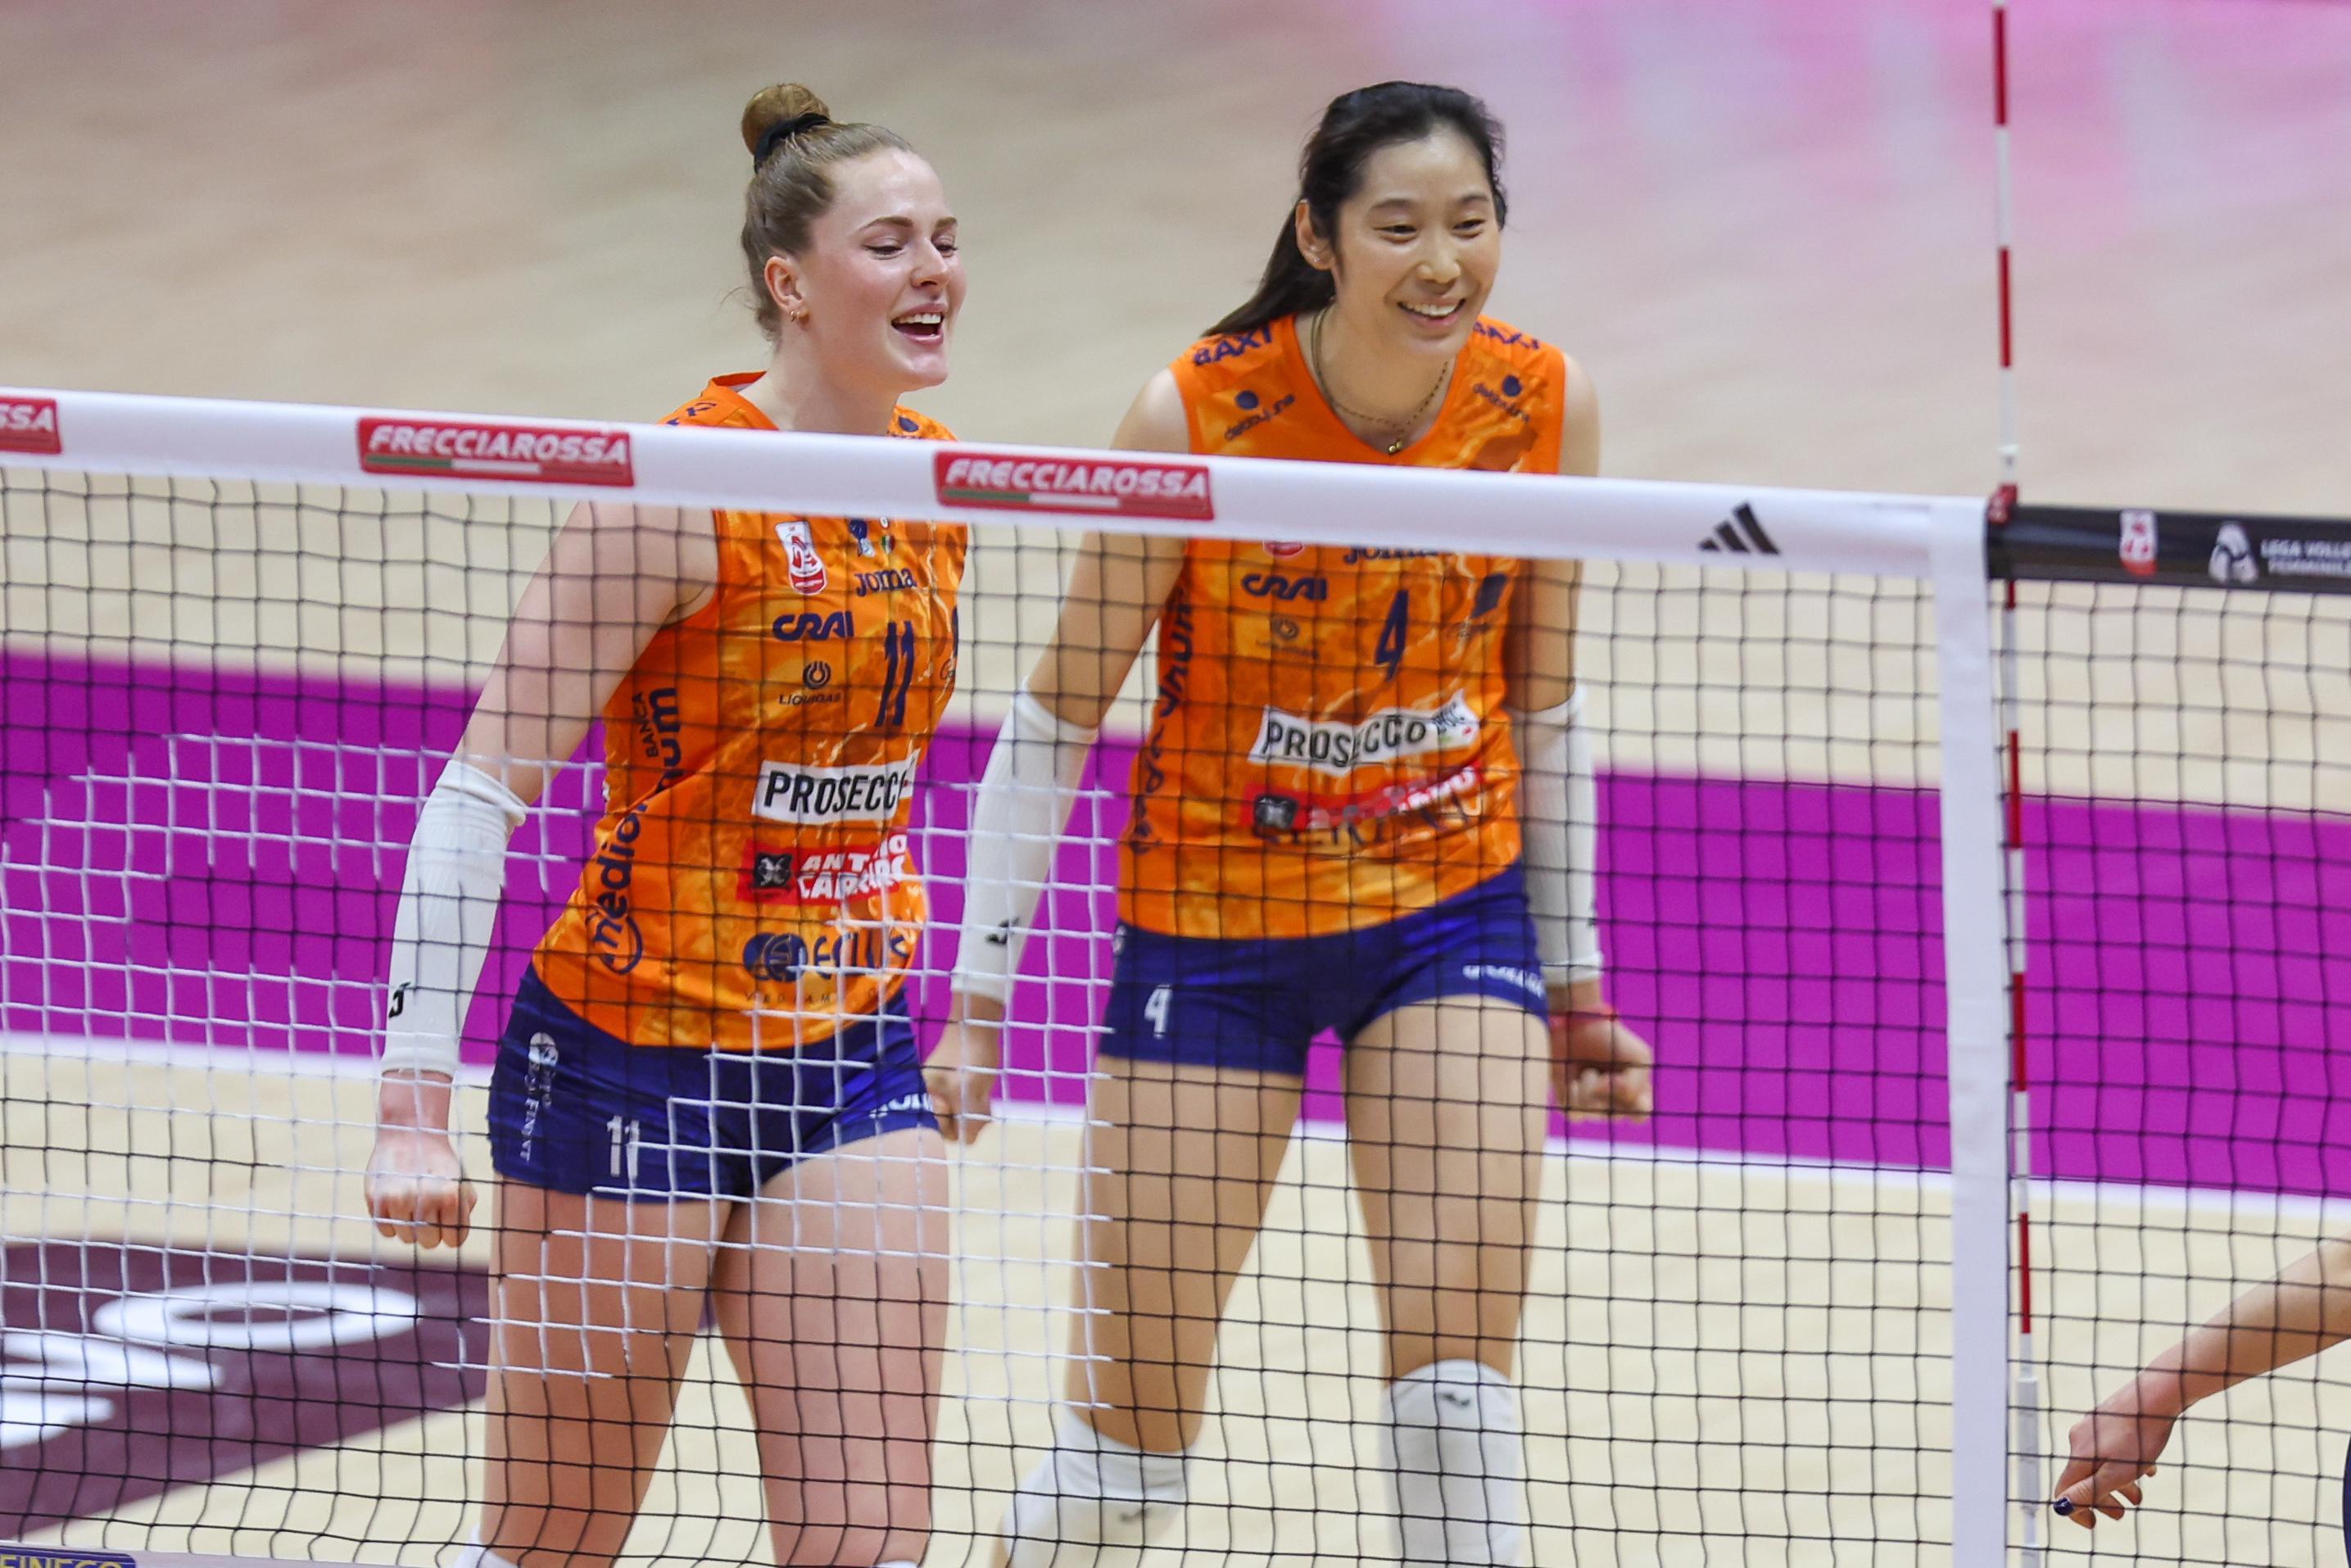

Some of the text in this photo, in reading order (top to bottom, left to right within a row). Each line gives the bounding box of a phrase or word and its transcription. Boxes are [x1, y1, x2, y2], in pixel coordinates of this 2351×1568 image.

[369, 424, 628, 465] FRECCIAROSSA
[945, 458, 1207, 499] FRECCIAROSSA
[772, 610, 855, 641] CRAI
[1374, 589, 1410, 682] 4
[874, 620, 916, 727] 11
[632, 692, 659, 759] BANCA
[1262, 716, 1426, 768] PROSCCO
[763, 770, 906, 815] PROSECC
[801, 834, 908, 872] ANTIO
[1144, 985, 1173, 1039] 4
[607, 1115, 641, 1181] 11
